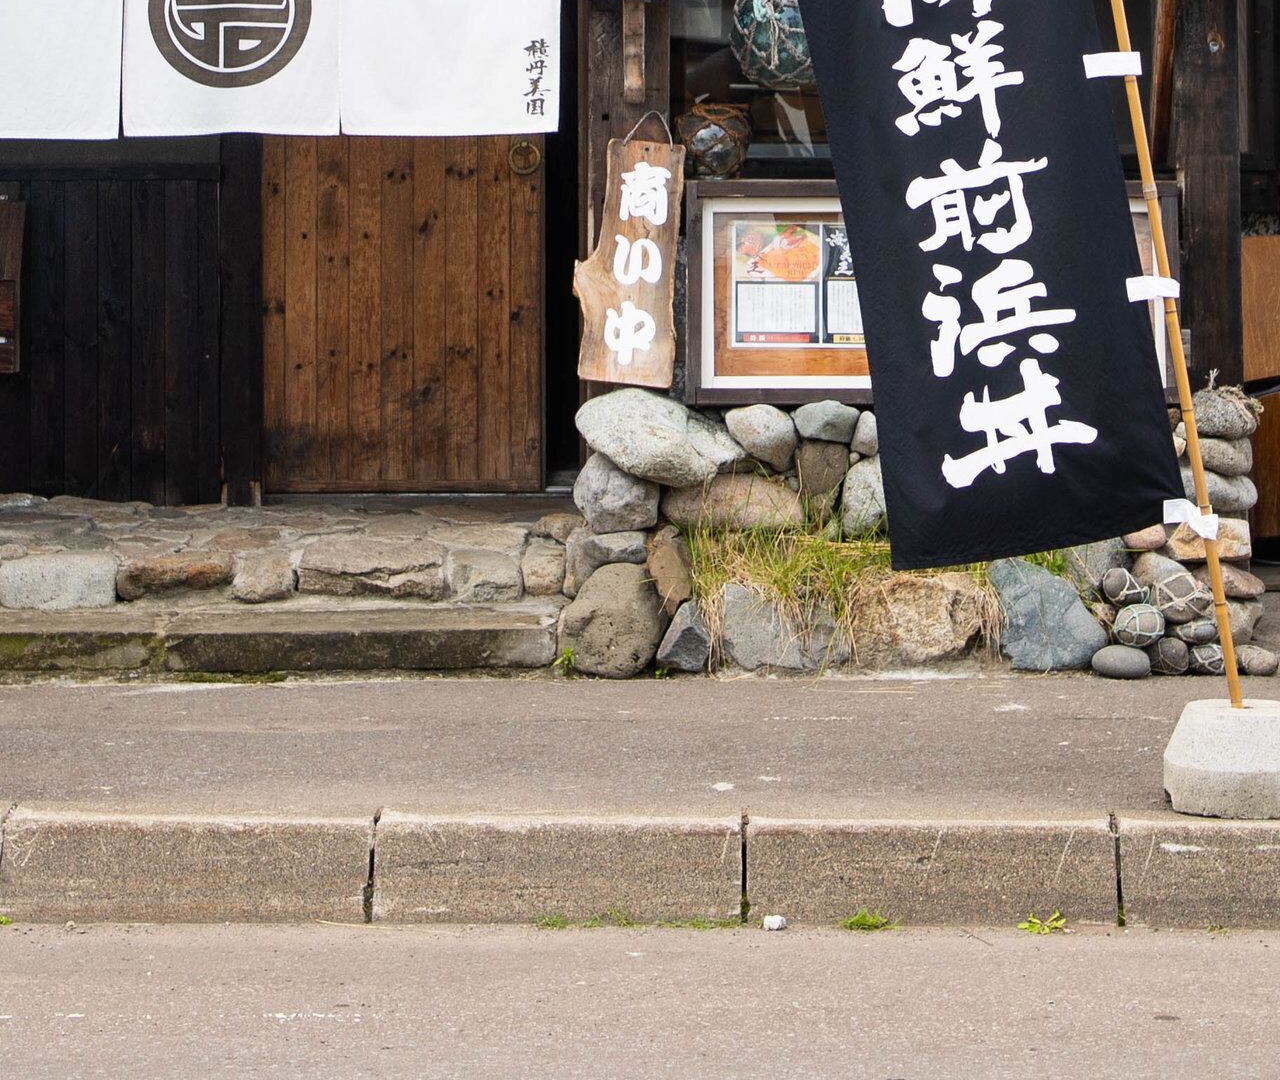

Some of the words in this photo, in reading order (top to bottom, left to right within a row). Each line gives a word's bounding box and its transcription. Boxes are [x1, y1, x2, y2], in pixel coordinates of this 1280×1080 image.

[524, 38, 551, 116] 積丹美国
[604, 162, 671, 365] 商い中
